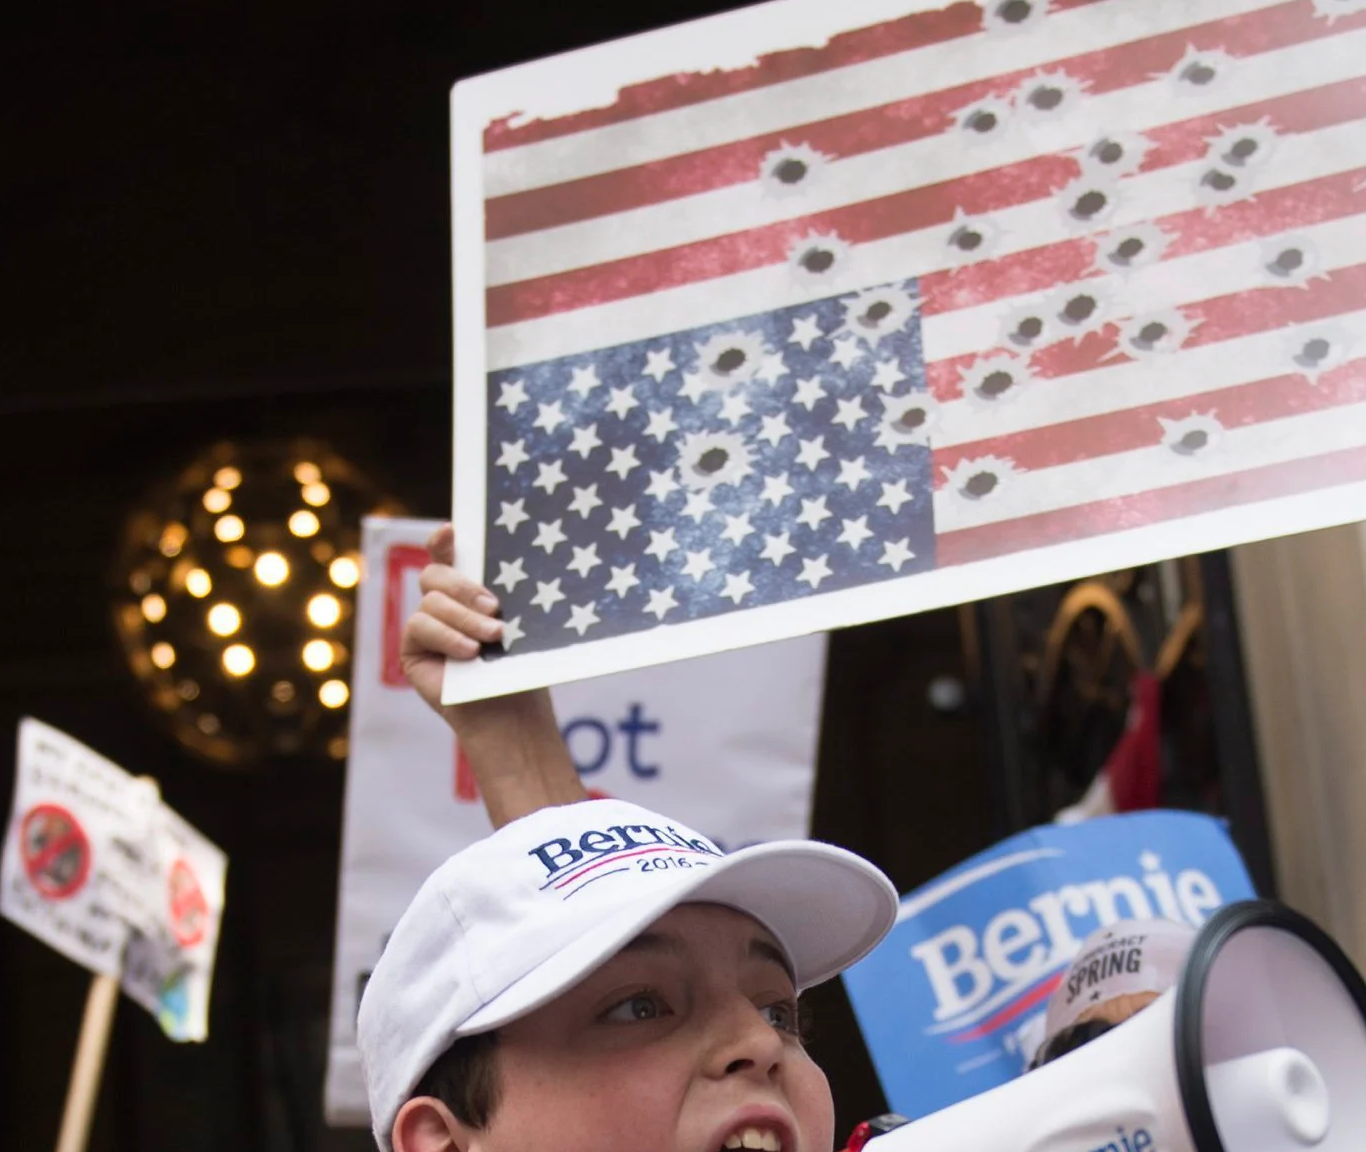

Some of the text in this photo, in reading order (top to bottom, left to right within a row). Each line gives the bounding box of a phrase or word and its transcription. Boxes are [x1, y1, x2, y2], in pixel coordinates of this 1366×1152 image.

[527, 823, 723, 879] Bernie
[636, 856, 692, 873] 2016
[908, 850, 1224, 1023] Bernie
[1065, 947, 1142, 1005] SPRING
